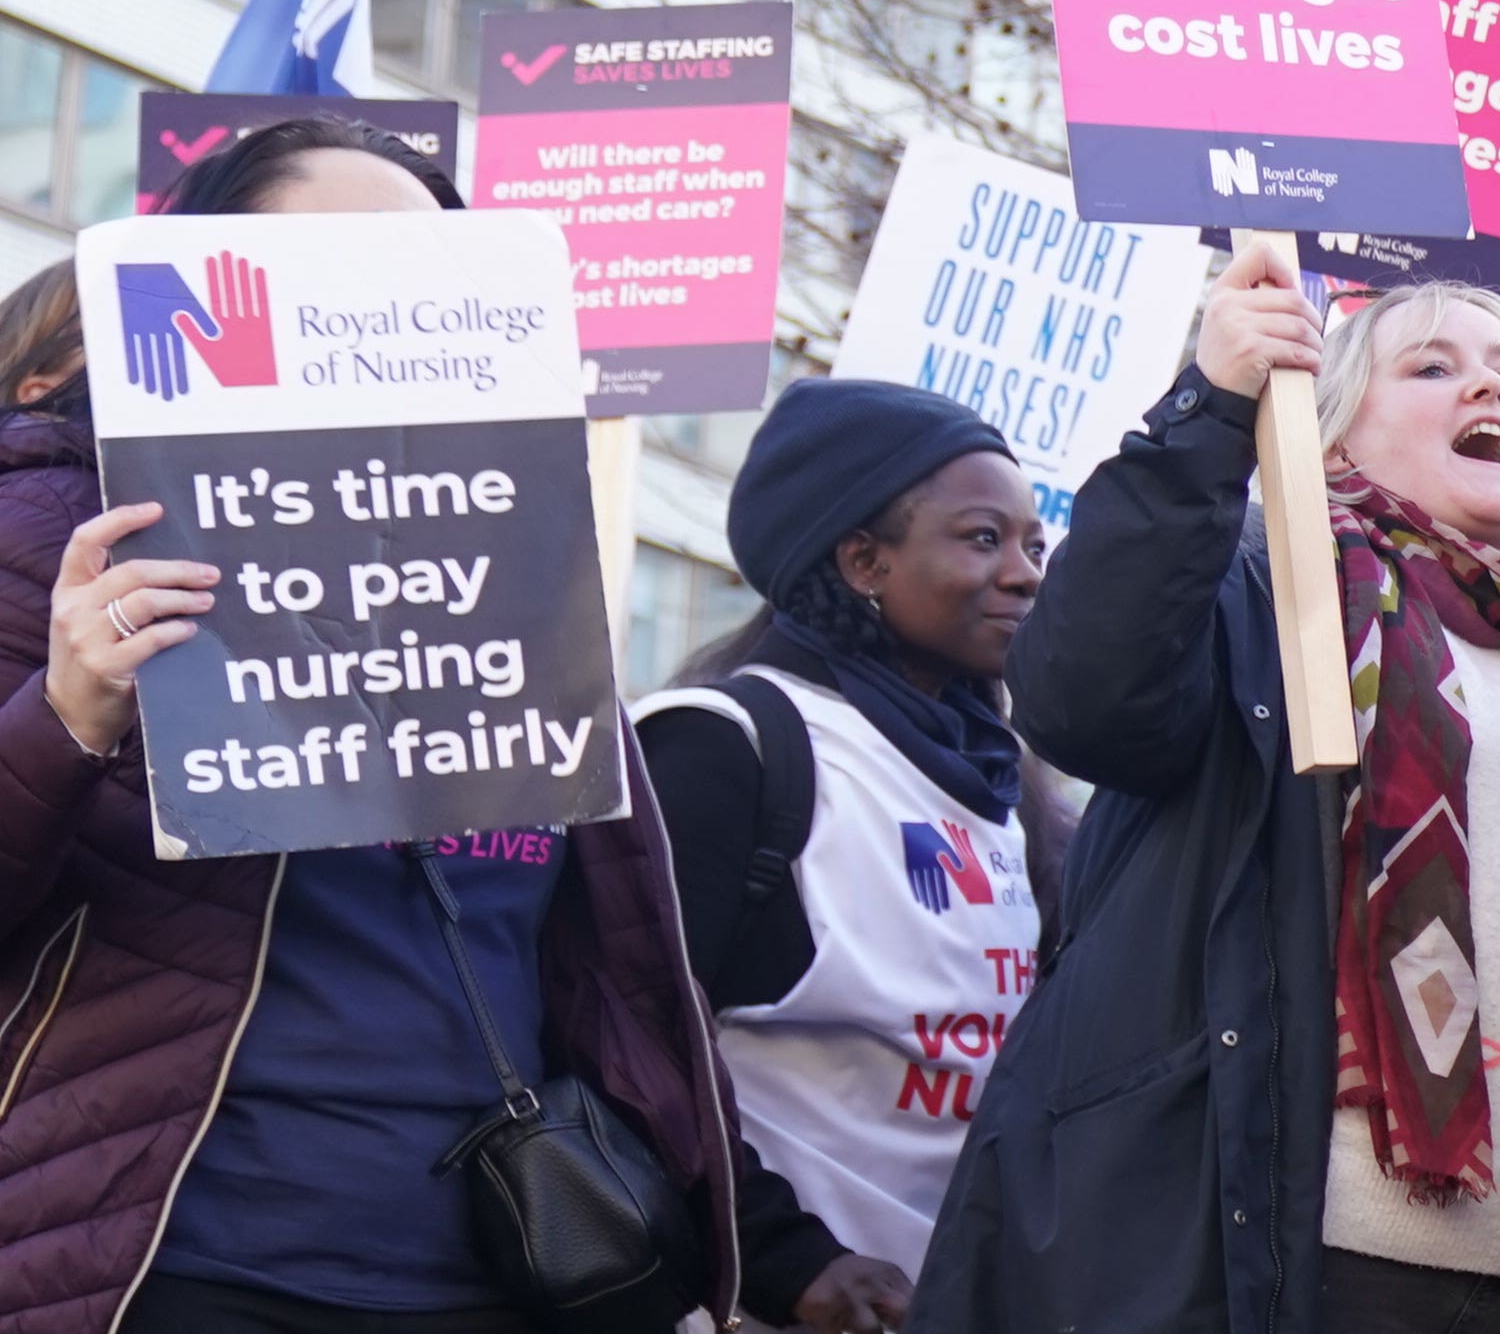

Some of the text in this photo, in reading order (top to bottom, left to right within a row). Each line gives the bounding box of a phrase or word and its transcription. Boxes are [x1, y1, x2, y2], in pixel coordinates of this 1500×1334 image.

[574, 36, 774, 64] SAFE STAFFING
[1108, 13, 1248, 61] cost
[1258, 12, 1405, 71] lives
[573, 59, 733, 84] SAVES LIVES
[538, 139, 725, 169] Will there be
[492, 167, 765, 203] enough staff when
[1262, 166, 1339, 188] Royal College
[1264, 183, 1324, 202] of Nursing
[579, 201, 651, 224] need
[656, 196, 735, 220] care?
[959, 182, 1143, 301] SUPPORT
[606, 255, 753, 280] shortages
[619, 282, 687, 307] lives
[297, 298, 545, 349] Royal College
[924, 259, 1122, 381] OUR NHS
[302, 348, 497, 392] of Nursing
[193, 458, 516, 529] It's time
[237, 555, 491, 621] to pay
[225, 629, 525, 703] nursing
[183, 708, 592, 793] staff fairly
[470, 830, 552, 865] LIVES
